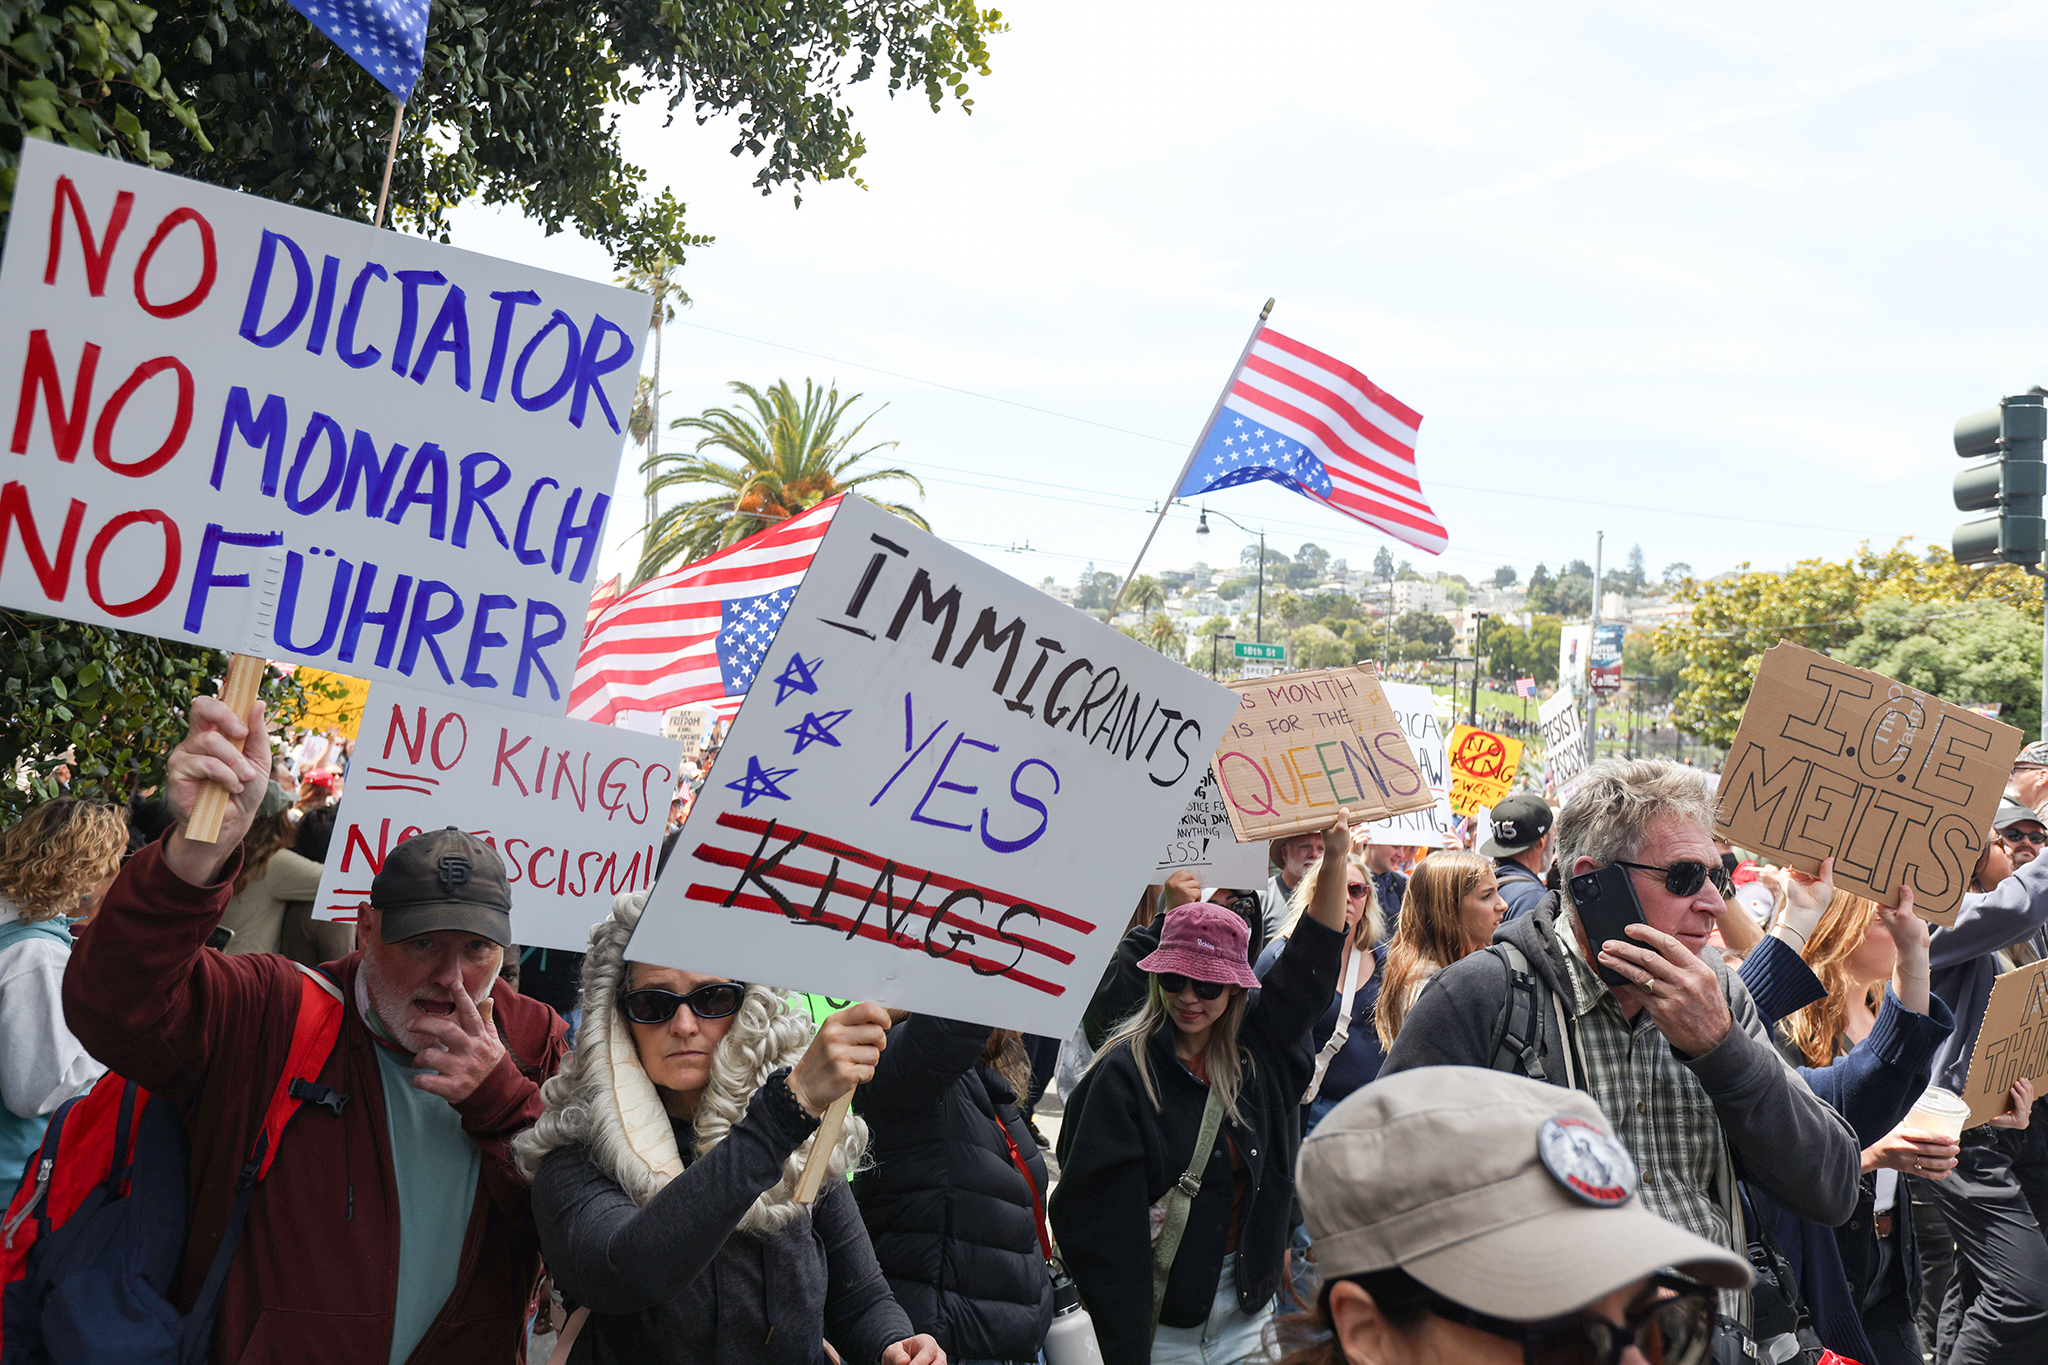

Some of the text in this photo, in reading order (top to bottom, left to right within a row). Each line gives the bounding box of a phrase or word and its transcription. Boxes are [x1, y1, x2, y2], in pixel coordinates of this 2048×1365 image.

[43, 174, 635, 435] NO DICTATOR
[11, 329, 611, 584] NO MONARCH
[0, 480, 567, 701] NO FÜHRER
[817, 532, 1201, 787] IMMIGRANTS
[1243, 646, 1276, 657] 18th St
[1245, 667, 1271, 675] SPEED
[670, 717, 701, 726] FREEDOM
[1266, 676, 1358, 707] MONTH
[1231, 708, 1353, 739] IS FOR THE
[1466, 736, 1501, 757] NO
[1542, 704, 1577, 752] RESIST
[382, 703, 468, 771] NO
[492, 727, 671, 825] KINGS
[870, 692, 1060, 855] YES
[1218, 731, 1421, 818] QUEENS
[1450, 751, 1516, 783] KING
[1549, 737, 1587, 788] FASCISM
[1176, 826, 1220, 840] ANYTHING
[1715, 741, 1982, 914] MELTS
[722, 818, 1041, 977] KINGS
[1984, 1020, 2048, 1095] THA
